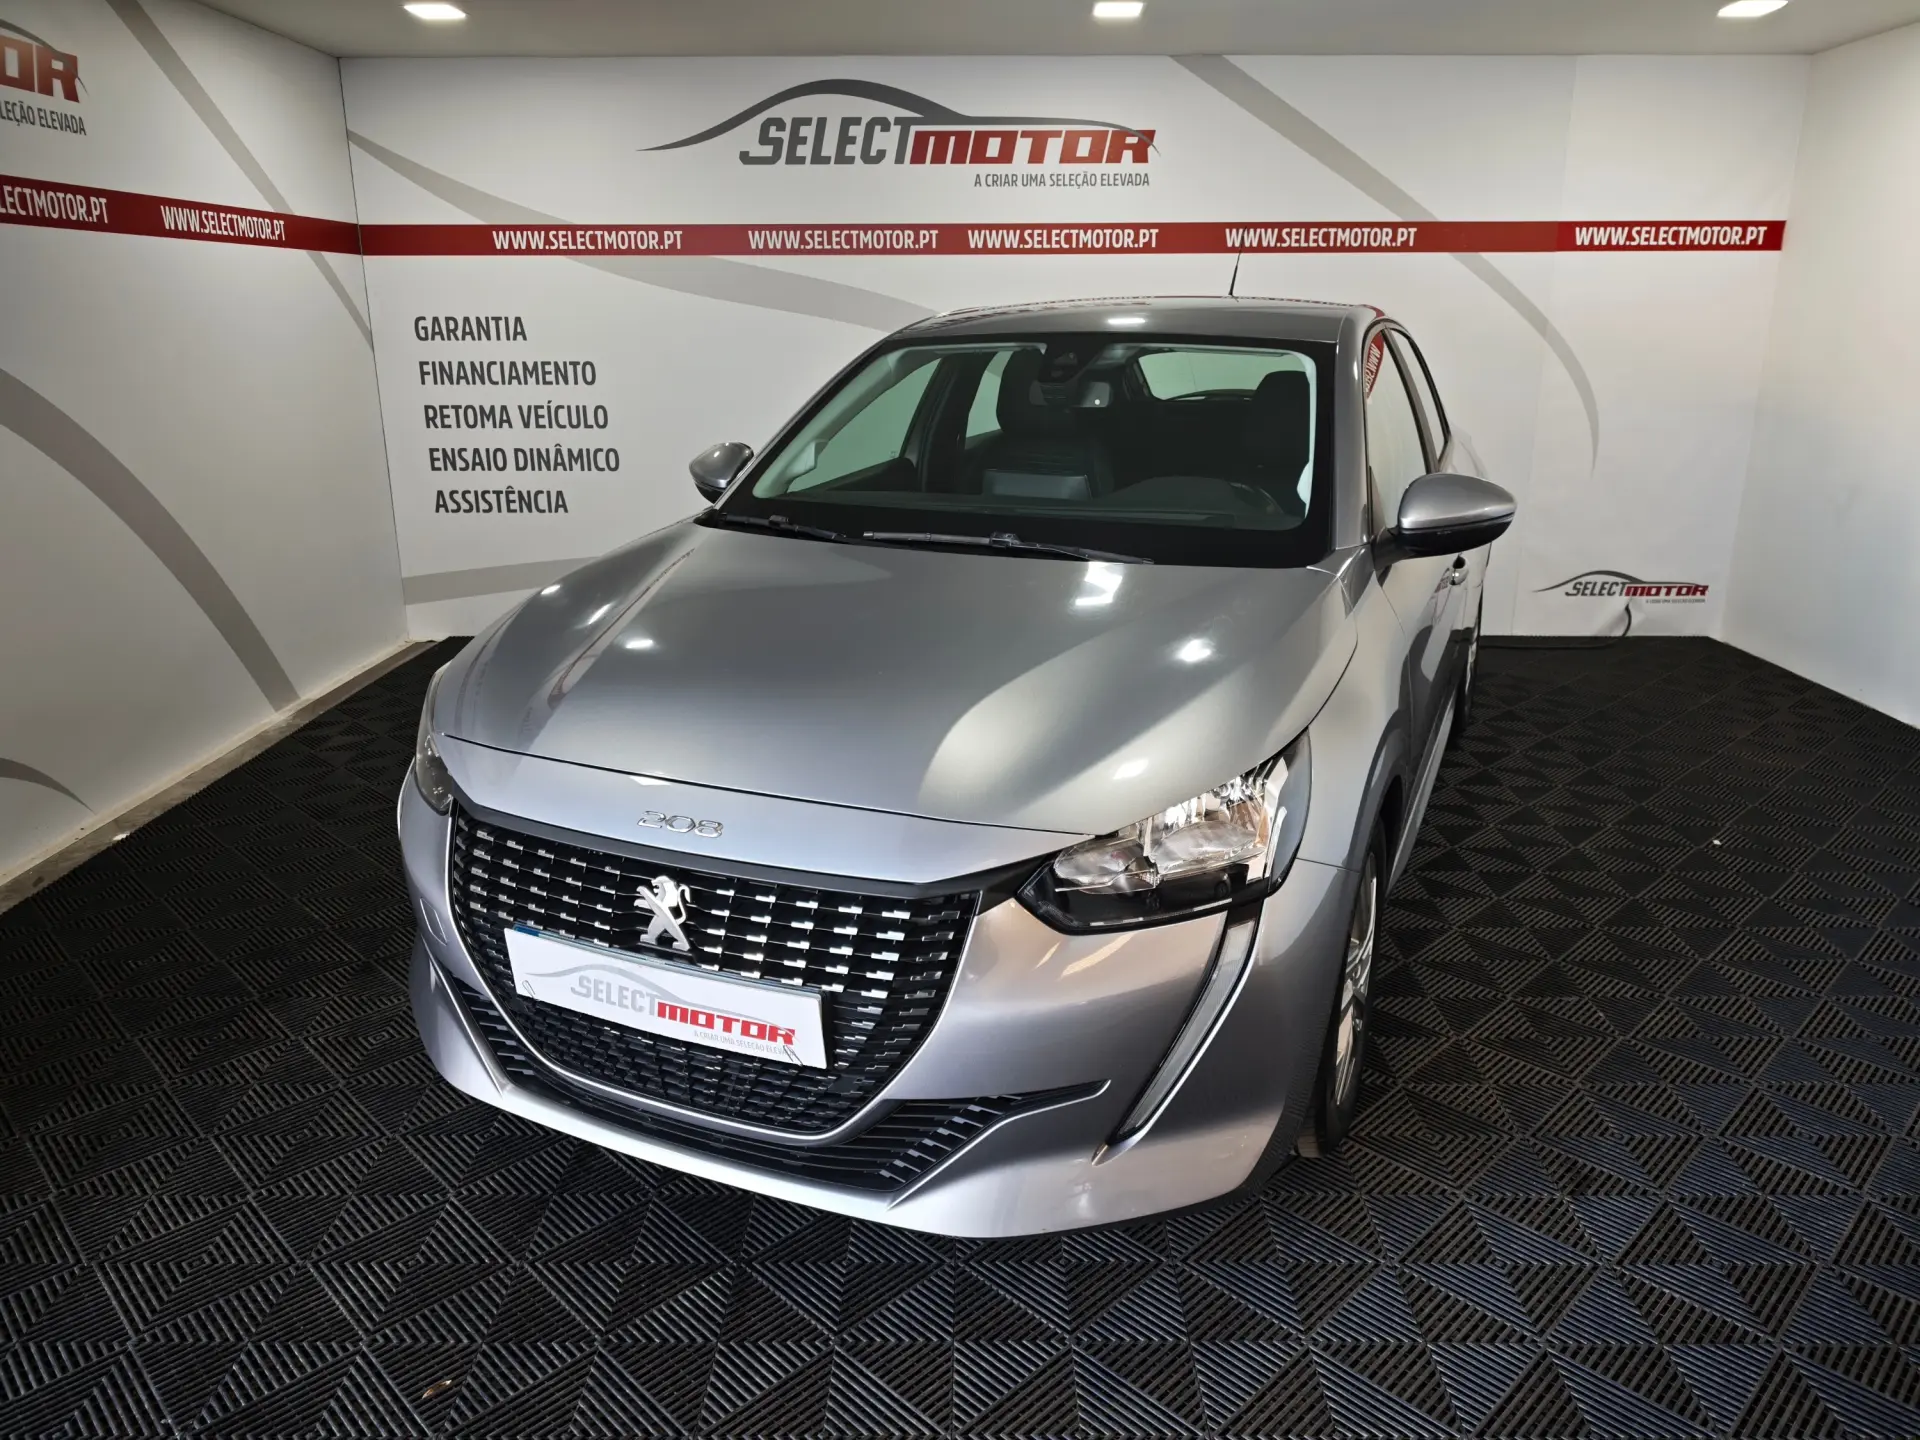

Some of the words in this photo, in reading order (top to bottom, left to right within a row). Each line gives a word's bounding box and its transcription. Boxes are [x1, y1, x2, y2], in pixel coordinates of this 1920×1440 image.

[37, 107, 87, 136] ELEVADA
[739, 117, 1156, 165] SELECTMOTOR
[974, 173, 982, 187] A
[985, 173, 1018, 187] CRIAR
[1021, 173, 1046, 187] UMA
[1049, 171, 1097, 189] SELEÇÃO
[1100, 173, 1150, 187] ELEVADA
[160, 205, 286, 241] WWW.SELECTMOTOR.PT
[492, 230, 683, 250] WWW.SELECTMOTOR.PT
[748, 229, 939, 250] WWW.SELECTMOTOR.PT
[968, 228, 1160, 249] WWW.SELECTMOTOR.PT
[1225, 227, 1418, 248] WWW.SELECTMOTOR.PT
[1575, 226, 1768, 246] WWW.SELECTMOTOR.PT
[414, 316, 527, 341] GARANTIA
[418, 361, 597, 386] FINANCIAMENTO
[424, 405, 513, 429] RETOMA
[517, 400, 609, 429] VEÍCULO
[428, 448, 508, 472] ENSAIO
[513, 443, 620, 472] DINÂMICO
[434, 485, 569, 513] ASSISTÊNCIA
[1565, 581, 1709, 597] SELECTMOTOR
[637, 810, 724, 838] 208
[570, 975, 796, 1046] SELECTMOTOR
[699, 1031, 719, 1042] CRIAR
